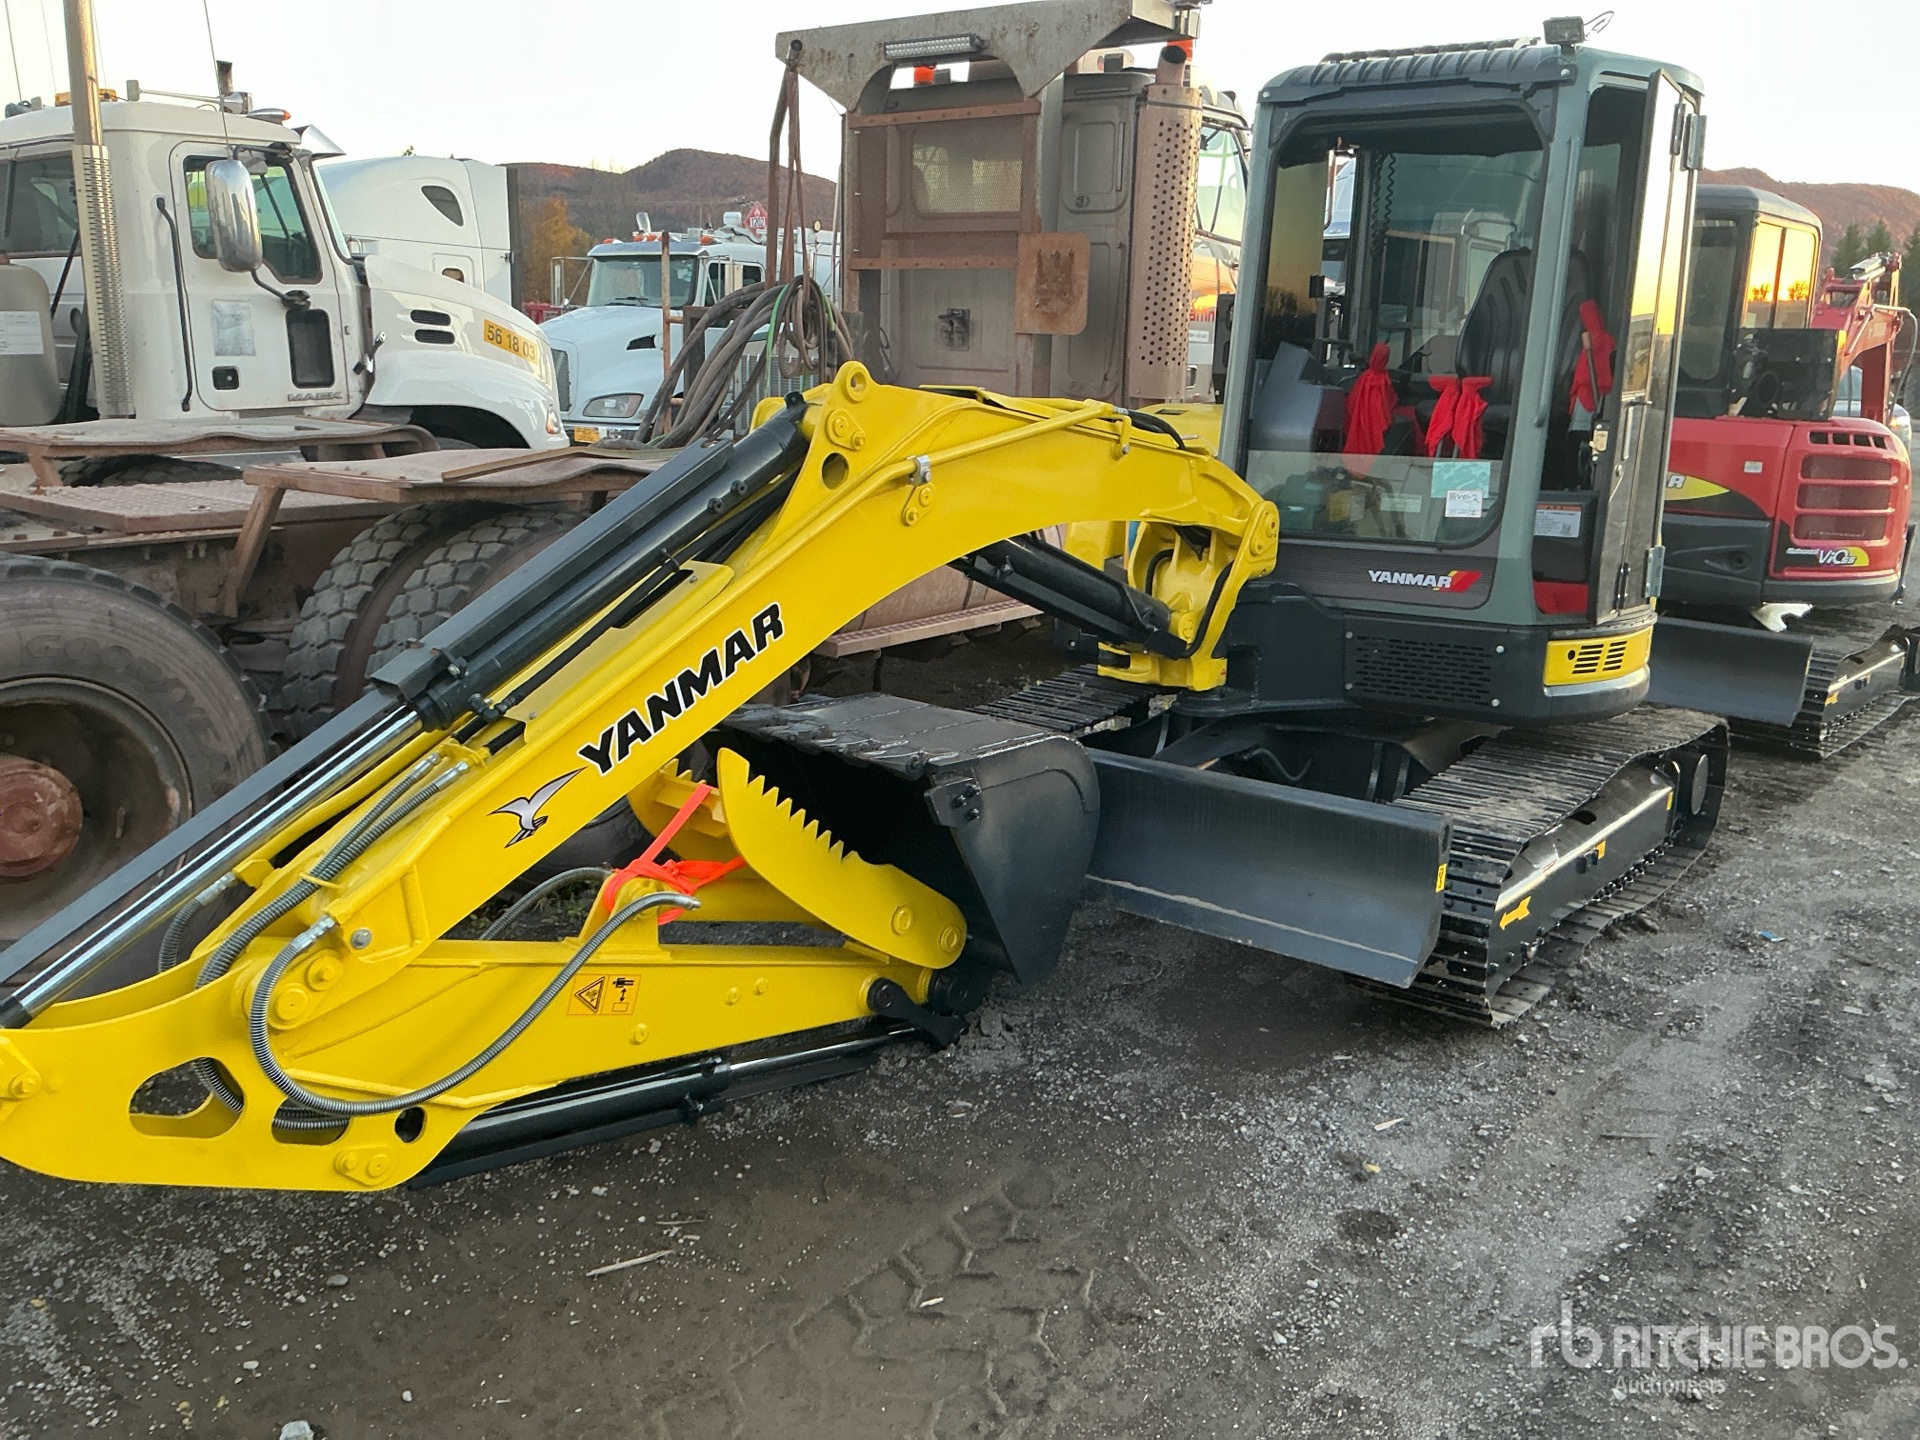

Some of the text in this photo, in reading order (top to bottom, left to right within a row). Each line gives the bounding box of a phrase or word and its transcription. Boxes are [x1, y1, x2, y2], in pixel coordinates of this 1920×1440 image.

[751, 218, 765, 227] 1202
[487, 325, 536, 360] 56 18 03
[1368, 570, 1452, 588] YANMAR
[577, 602, 785, 777] YANMAR
